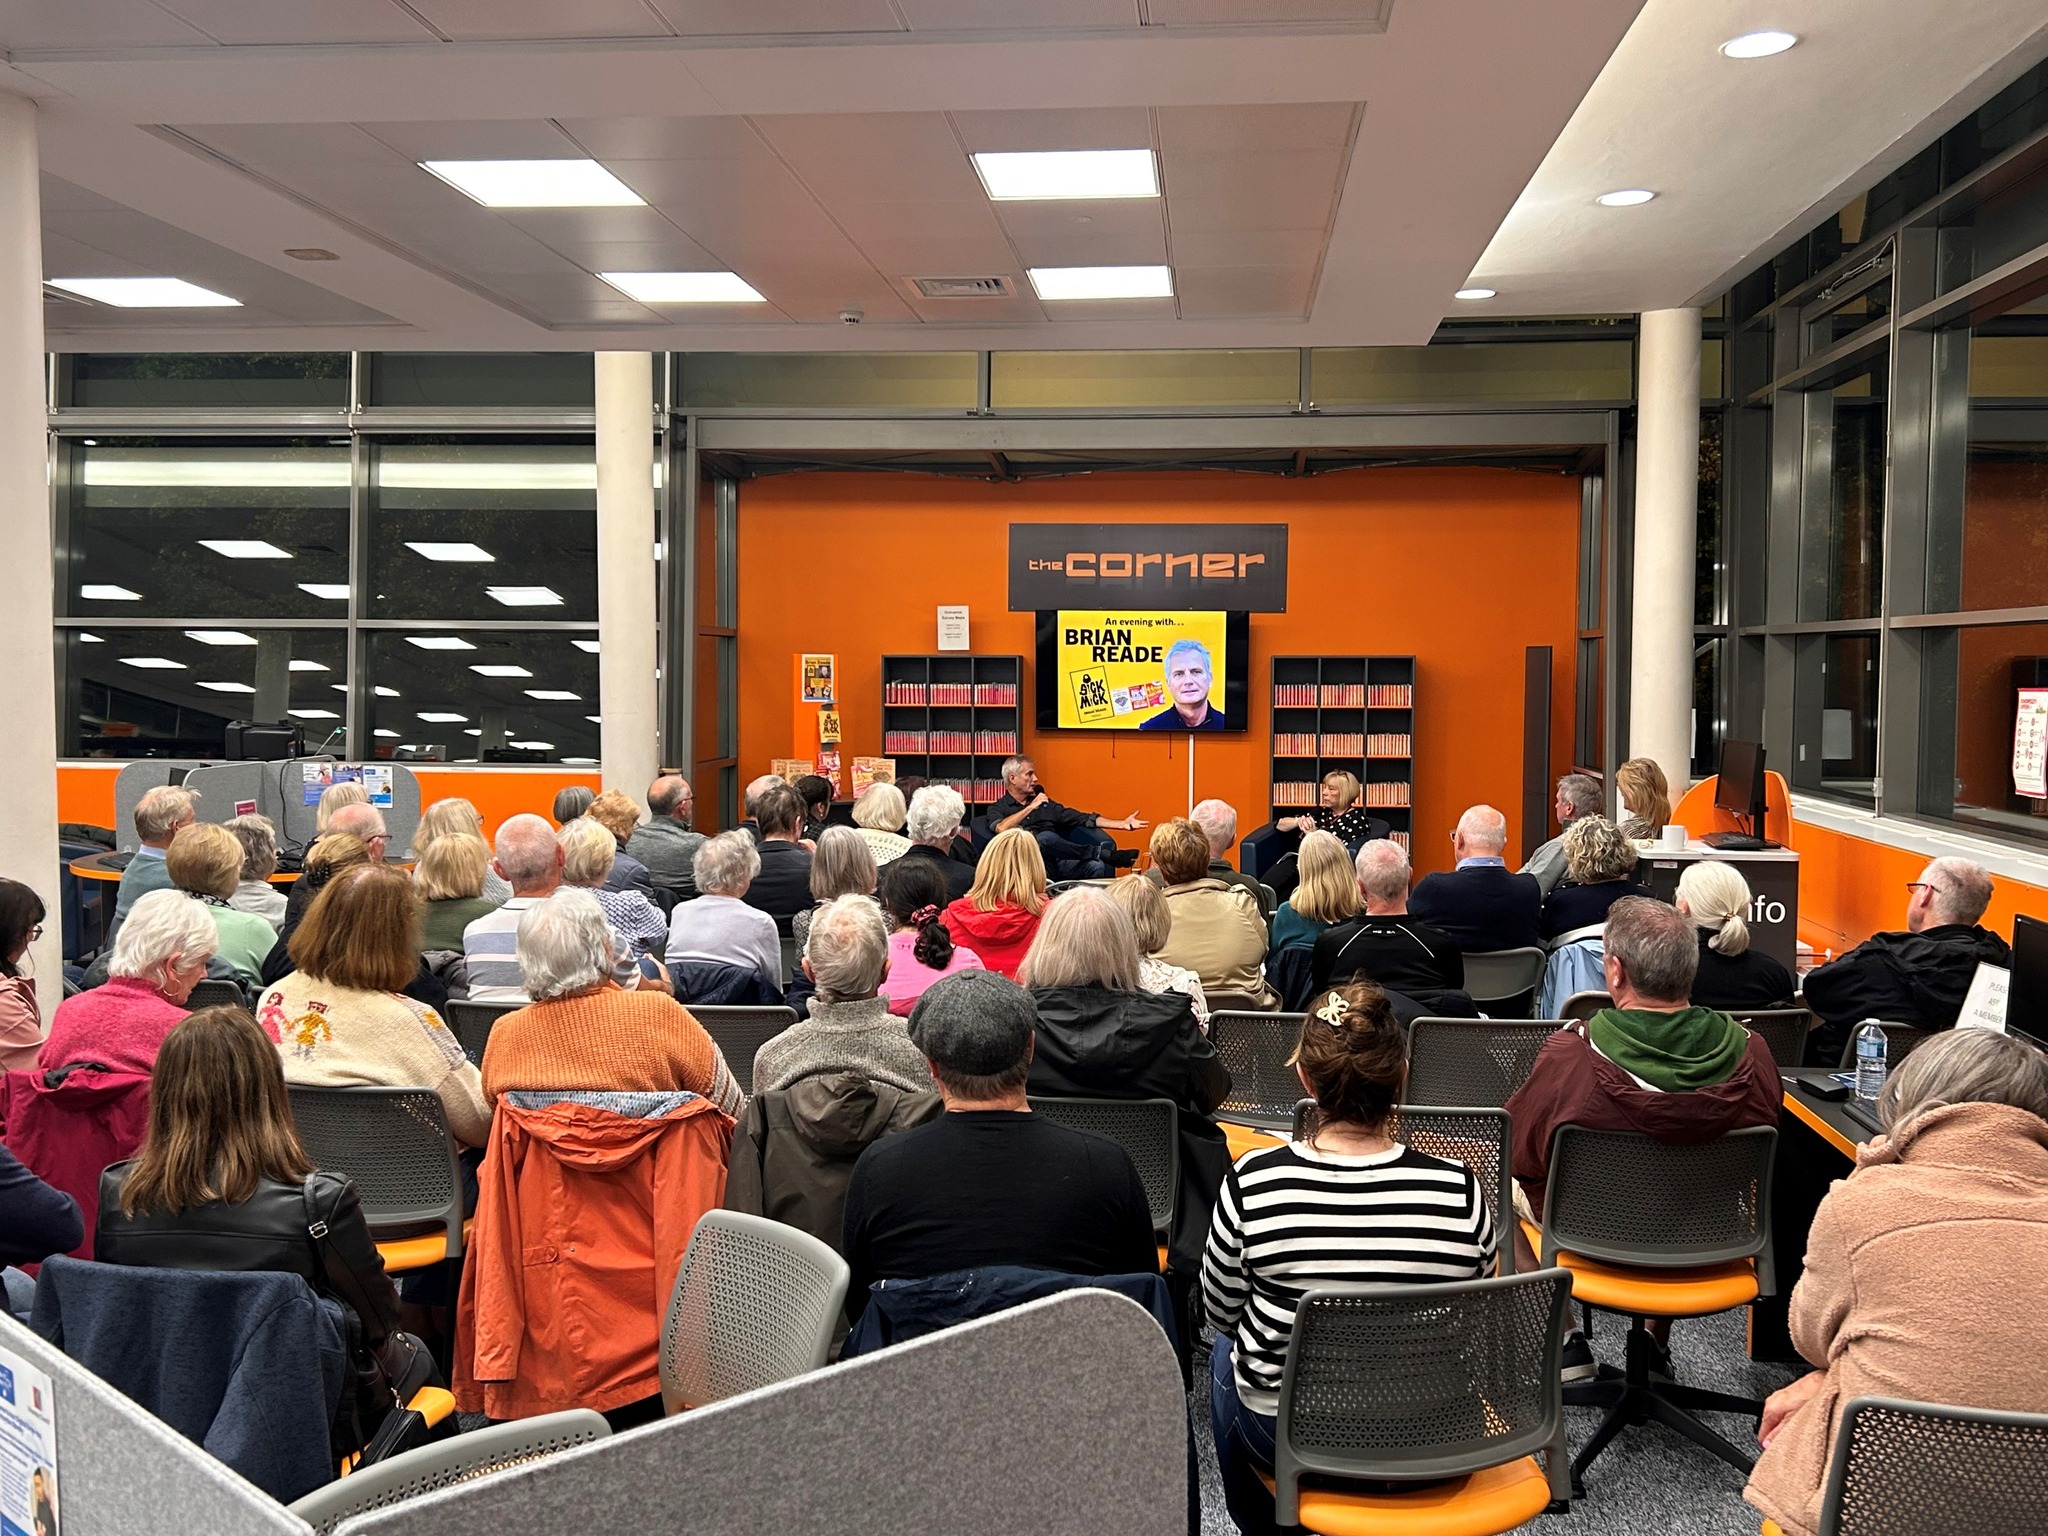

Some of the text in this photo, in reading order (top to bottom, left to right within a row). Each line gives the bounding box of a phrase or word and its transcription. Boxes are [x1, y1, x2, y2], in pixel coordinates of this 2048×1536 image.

[1028, 553, 1265, 578] the corner
[1105, 618, 1117, 626] An
[1119, 618, 1153, 627] evening
[1065, 629, 1131, 645] BRIAN
[1092, 646, 1163, 663] READE
[1748, 894, 1786, 924] fo
[1989, 982, 2010, 994] PLEAS
